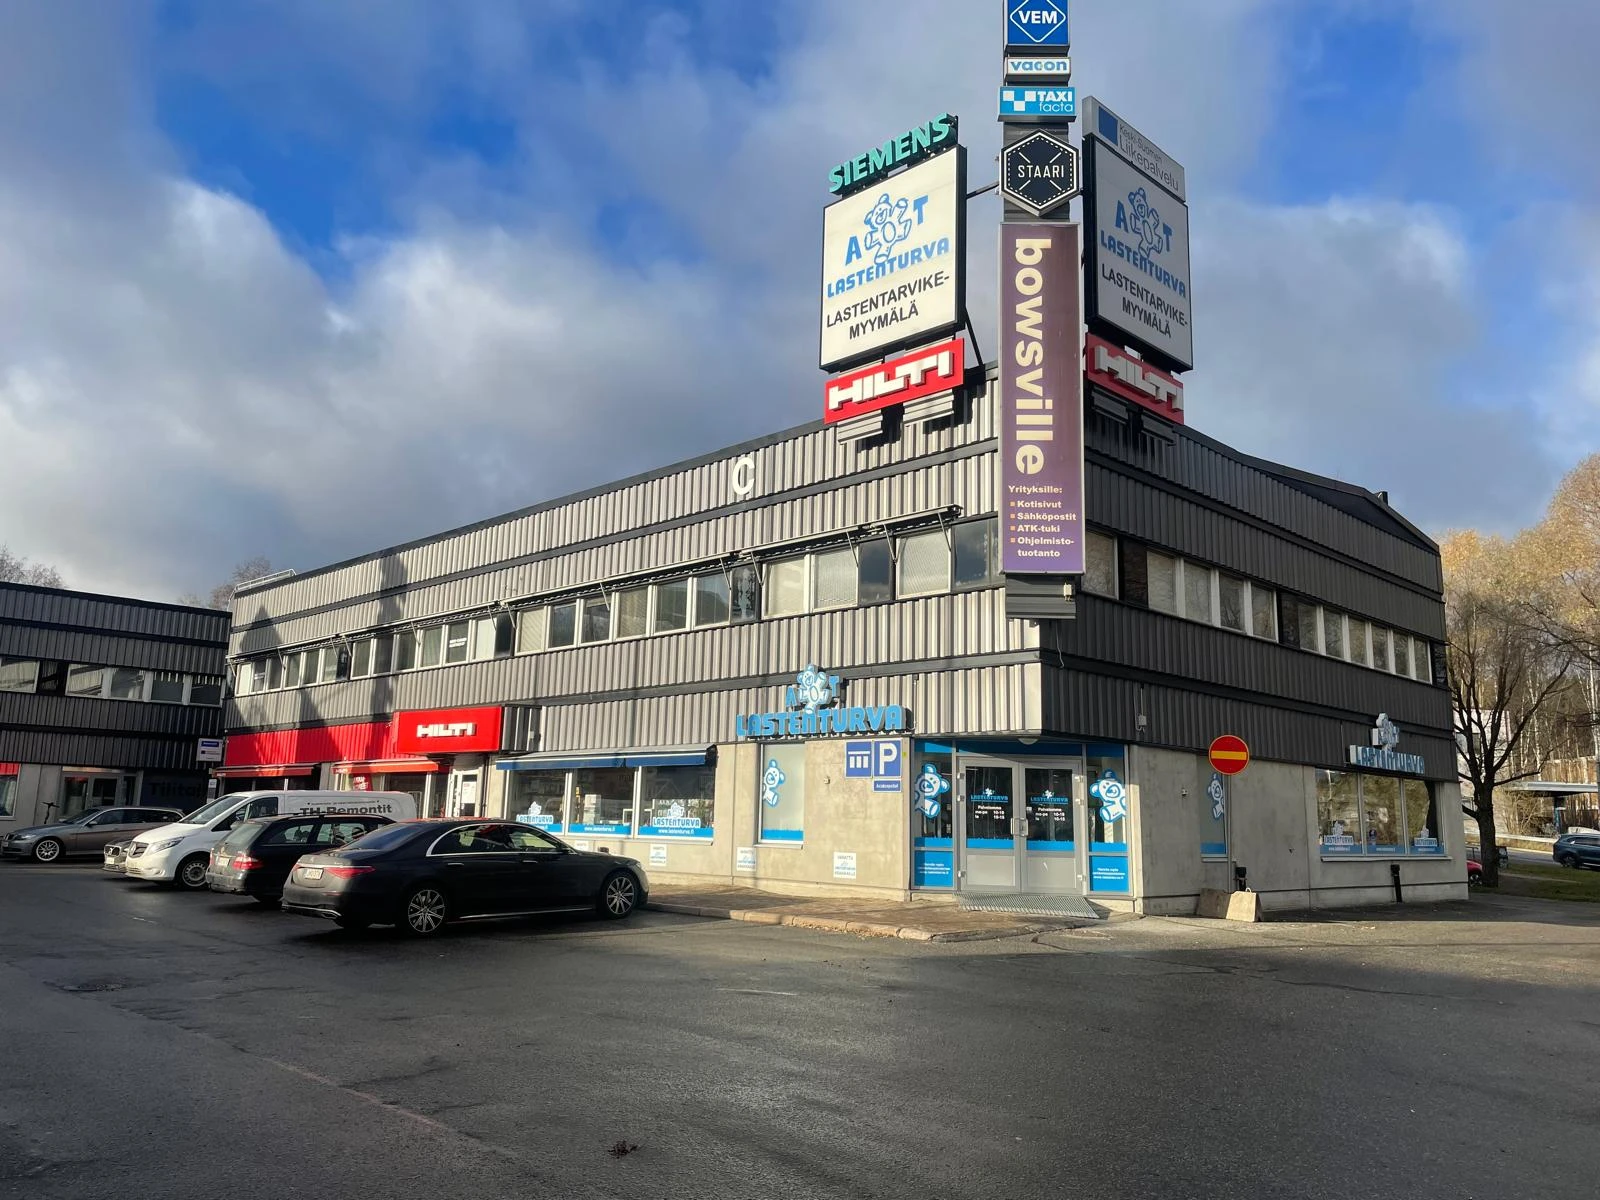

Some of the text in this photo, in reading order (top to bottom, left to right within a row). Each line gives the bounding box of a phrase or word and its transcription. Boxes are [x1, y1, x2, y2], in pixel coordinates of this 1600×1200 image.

[1018, 11, 1058, 24] VEM
[1010, 61, 1068, 71] vacon
[1037, 91, 1073, 102] TAXI
[1039, 102, 1074, 112] facta
[828, 112, 950, 193] SIEMENS
[1120, 134, 1179, 192] Liikepalvelu
[1018, 165, 1064, 178] STAARI
[845, 195, 929, 266] A T
[1115, 200, 1173, 252] A T
[827, 237, 950, 298] LASTENTURVA
[1100, 230, 1187, 299] LASTENTURVA
[826, 270, 950, 328] LASTENTARVIKE-
[1101, 263, 1188, 328] LASTENTARVIKE-
[849, 299, 919, 340] MYYMÄLÄ
[1122, 297, 1171, 339] MYYMÄLÄ
[1015, 238, 1053, 475] bowsville
[828, 350, 953, 410] HILTI
[1095, 345, 1184, 412] HILTI
[732, 457, 755, 496] C
[1008, 485, 1063, 495] Yrityksille:
[1017, 500, 1062, 509] Kotisivut
[1017, 512, 1077, 522] Sähköpostit
[1017, 524, 1061, 533] ATK-tuki
[1017, 537, 1075, 546] Ohjelmisto-
[1017, 549, 1061, 557] tuotanto
[786, 675, 840, 708] A T
[416, 722, 475, 738] HILTI
[736, 704, 904, 737] LASTENTURVA
[879, 742, 898, 775] P
[653, 817, 700, 827] LASTENTURVA
